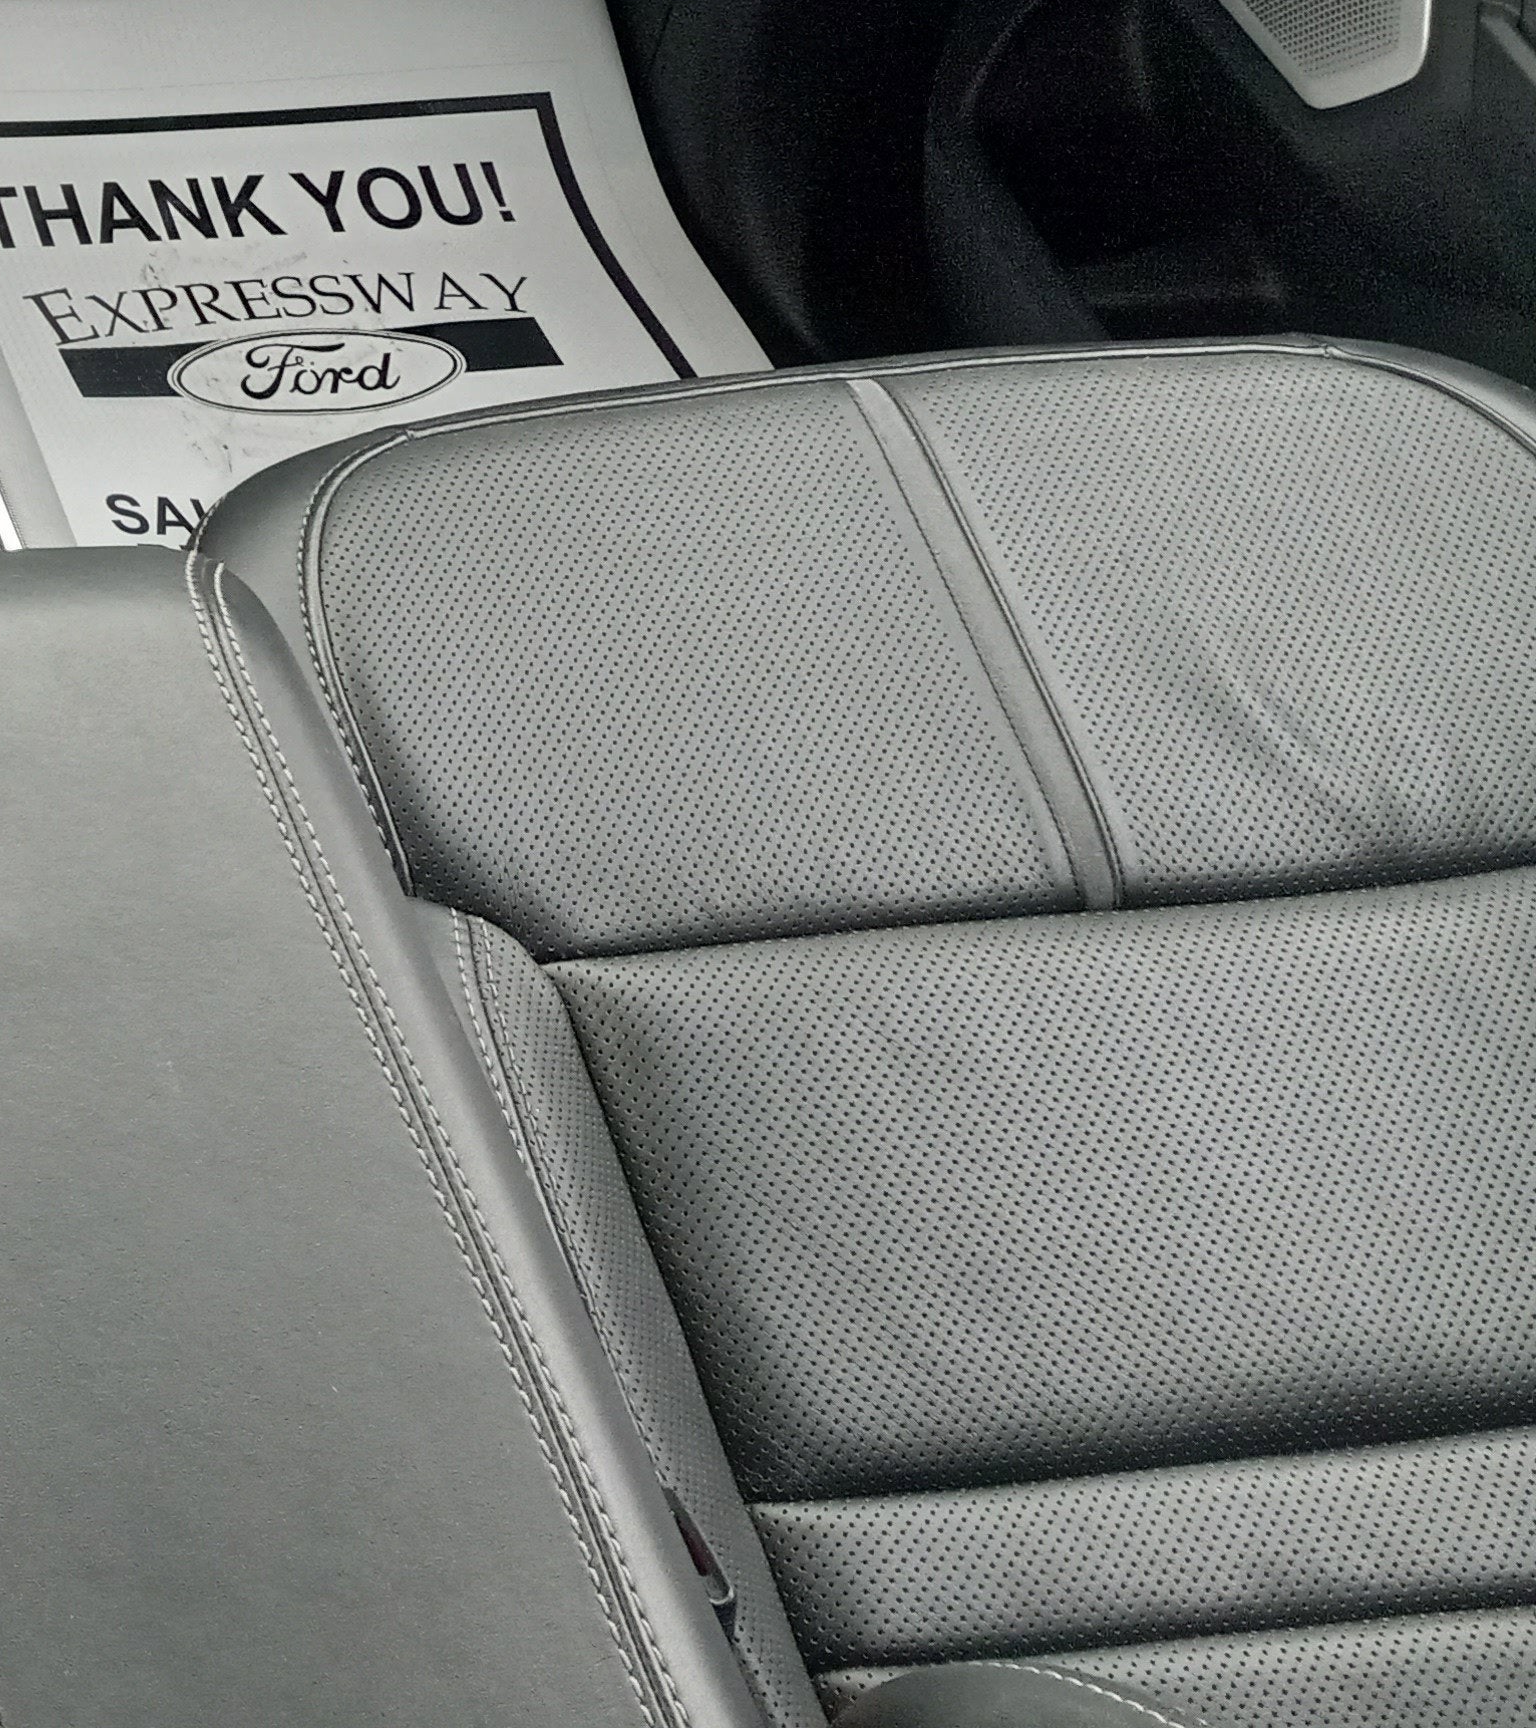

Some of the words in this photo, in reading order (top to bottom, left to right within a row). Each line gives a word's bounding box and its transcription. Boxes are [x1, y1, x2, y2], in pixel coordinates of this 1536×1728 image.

[290, 161, 518, 235] YOU!
[23, 271, 529, 347] EXPRESSWAY
[239, 343, 402, 402] Ford
